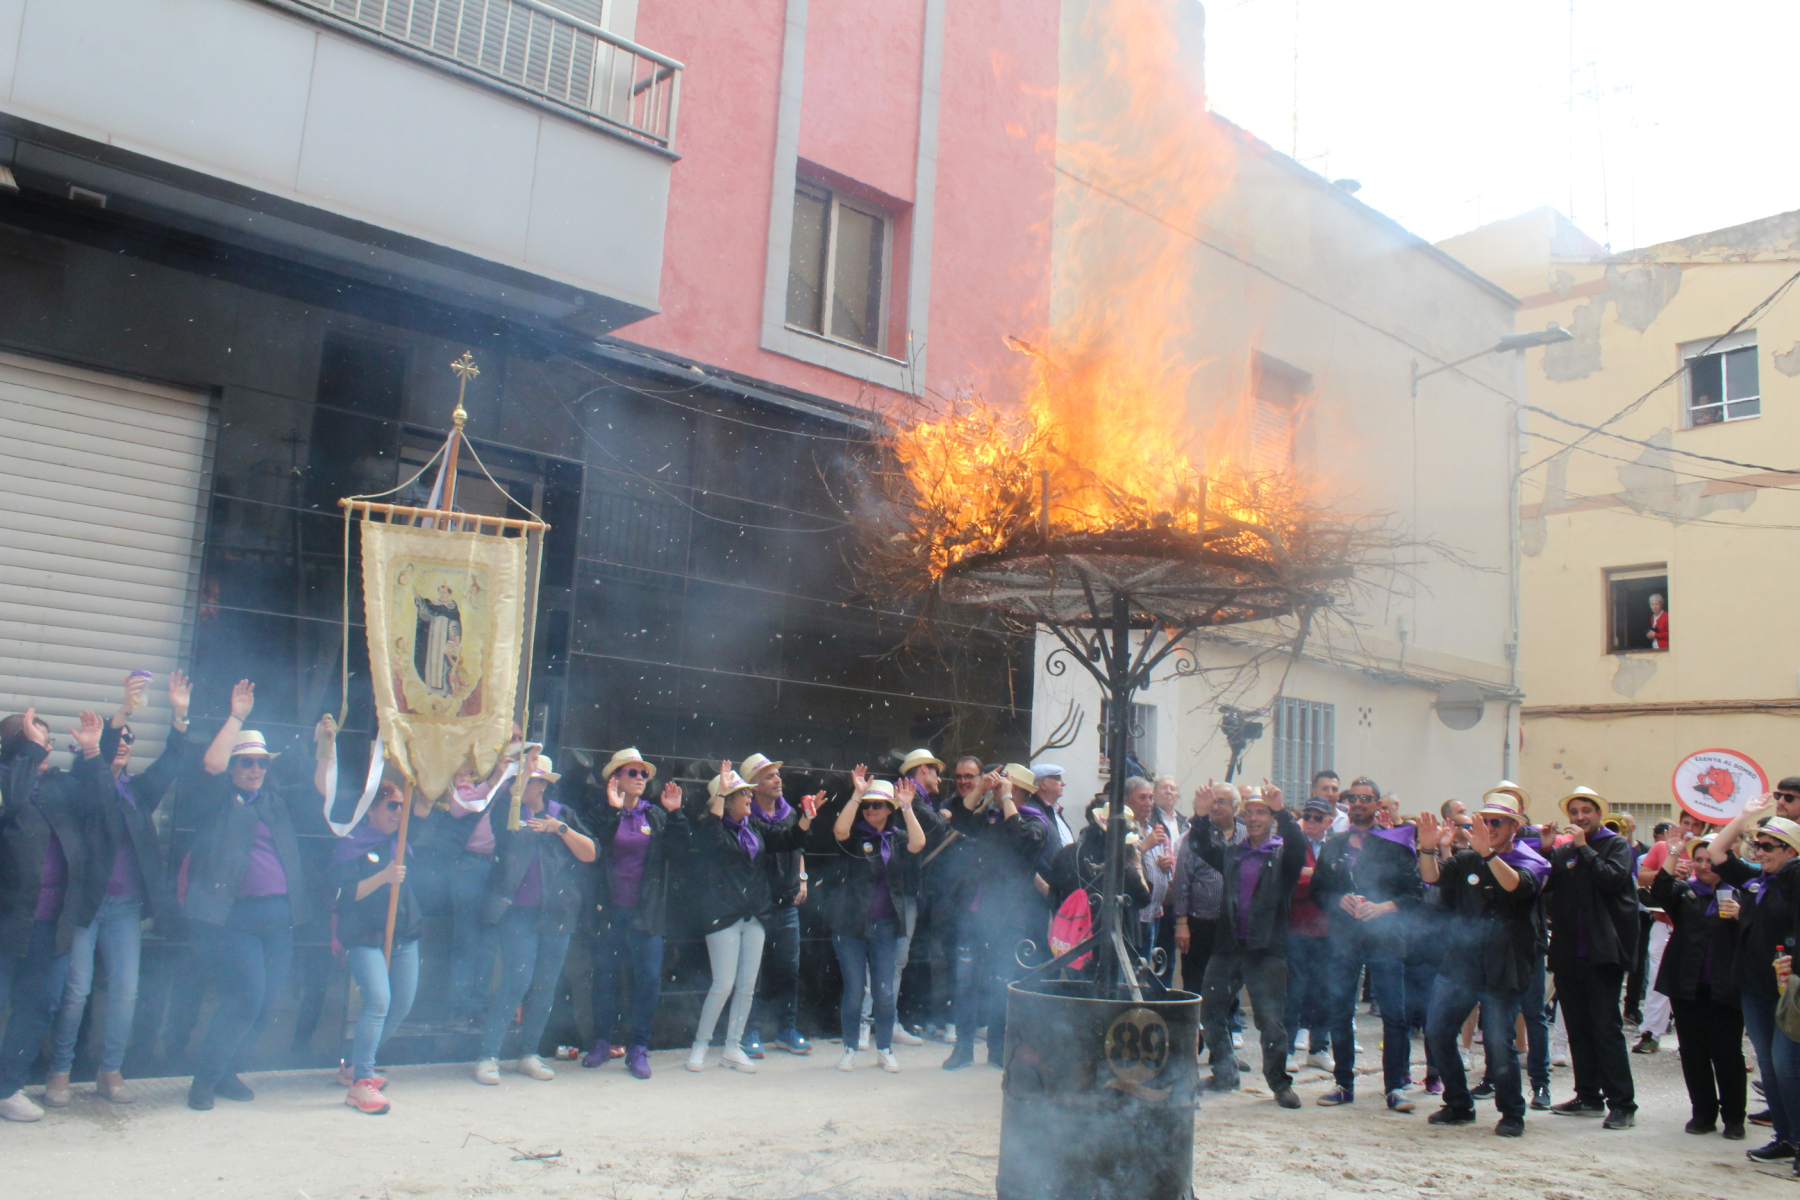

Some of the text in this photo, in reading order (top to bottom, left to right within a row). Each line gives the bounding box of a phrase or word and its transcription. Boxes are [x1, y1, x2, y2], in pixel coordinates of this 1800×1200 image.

[1733, 763, 1757, 779] BOMBO
[1694, 800, 1723, 812] XARANGA
[1110, 1022, 1166, 1069] 89
